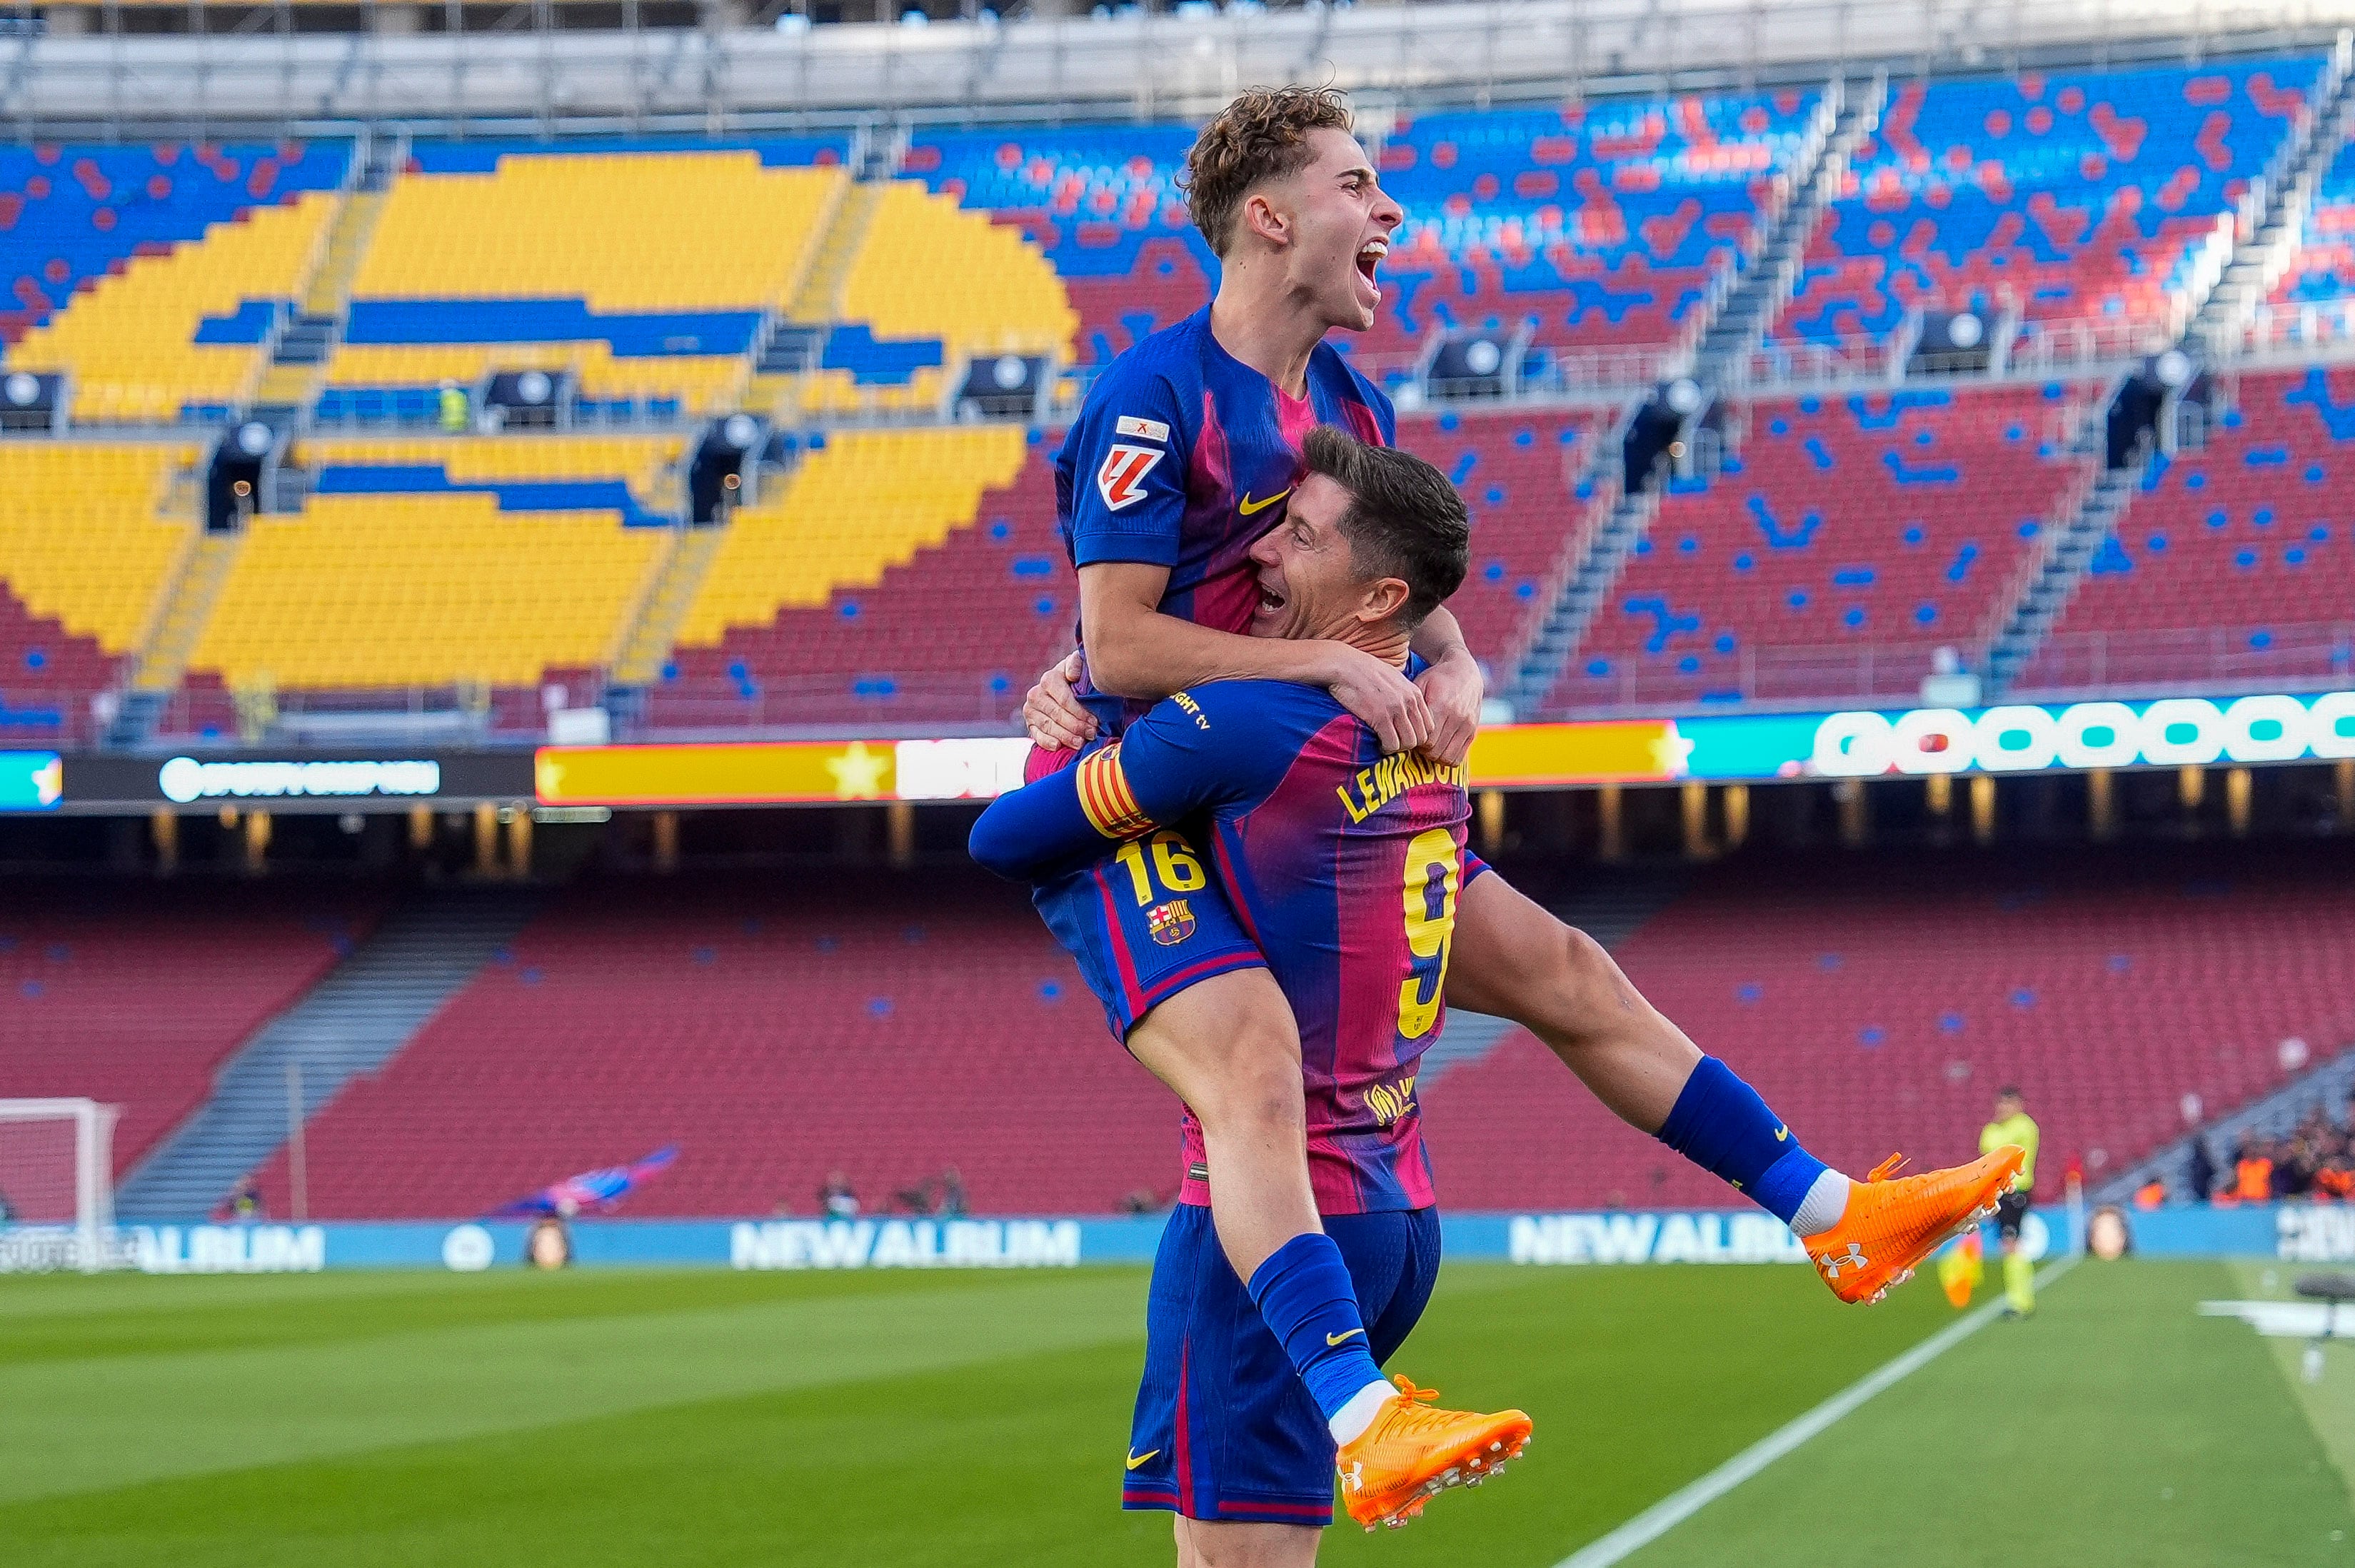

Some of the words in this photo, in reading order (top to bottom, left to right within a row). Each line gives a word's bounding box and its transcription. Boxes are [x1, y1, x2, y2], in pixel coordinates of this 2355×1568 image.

[1170, 690, 1200, 715] IGHT
[1195, 714, 1211, 730] tv
[1115, 830, 1206, 908] 16
[1397, 828, 1460, 1040] 9
[728, 1219, 875, 1270] NEW
[867, 1218, 1083, 1269] ALBUM
[1508, 1214, 1659, 1265] NEW
[1648, 1213, 1812, 1264] ALBU
